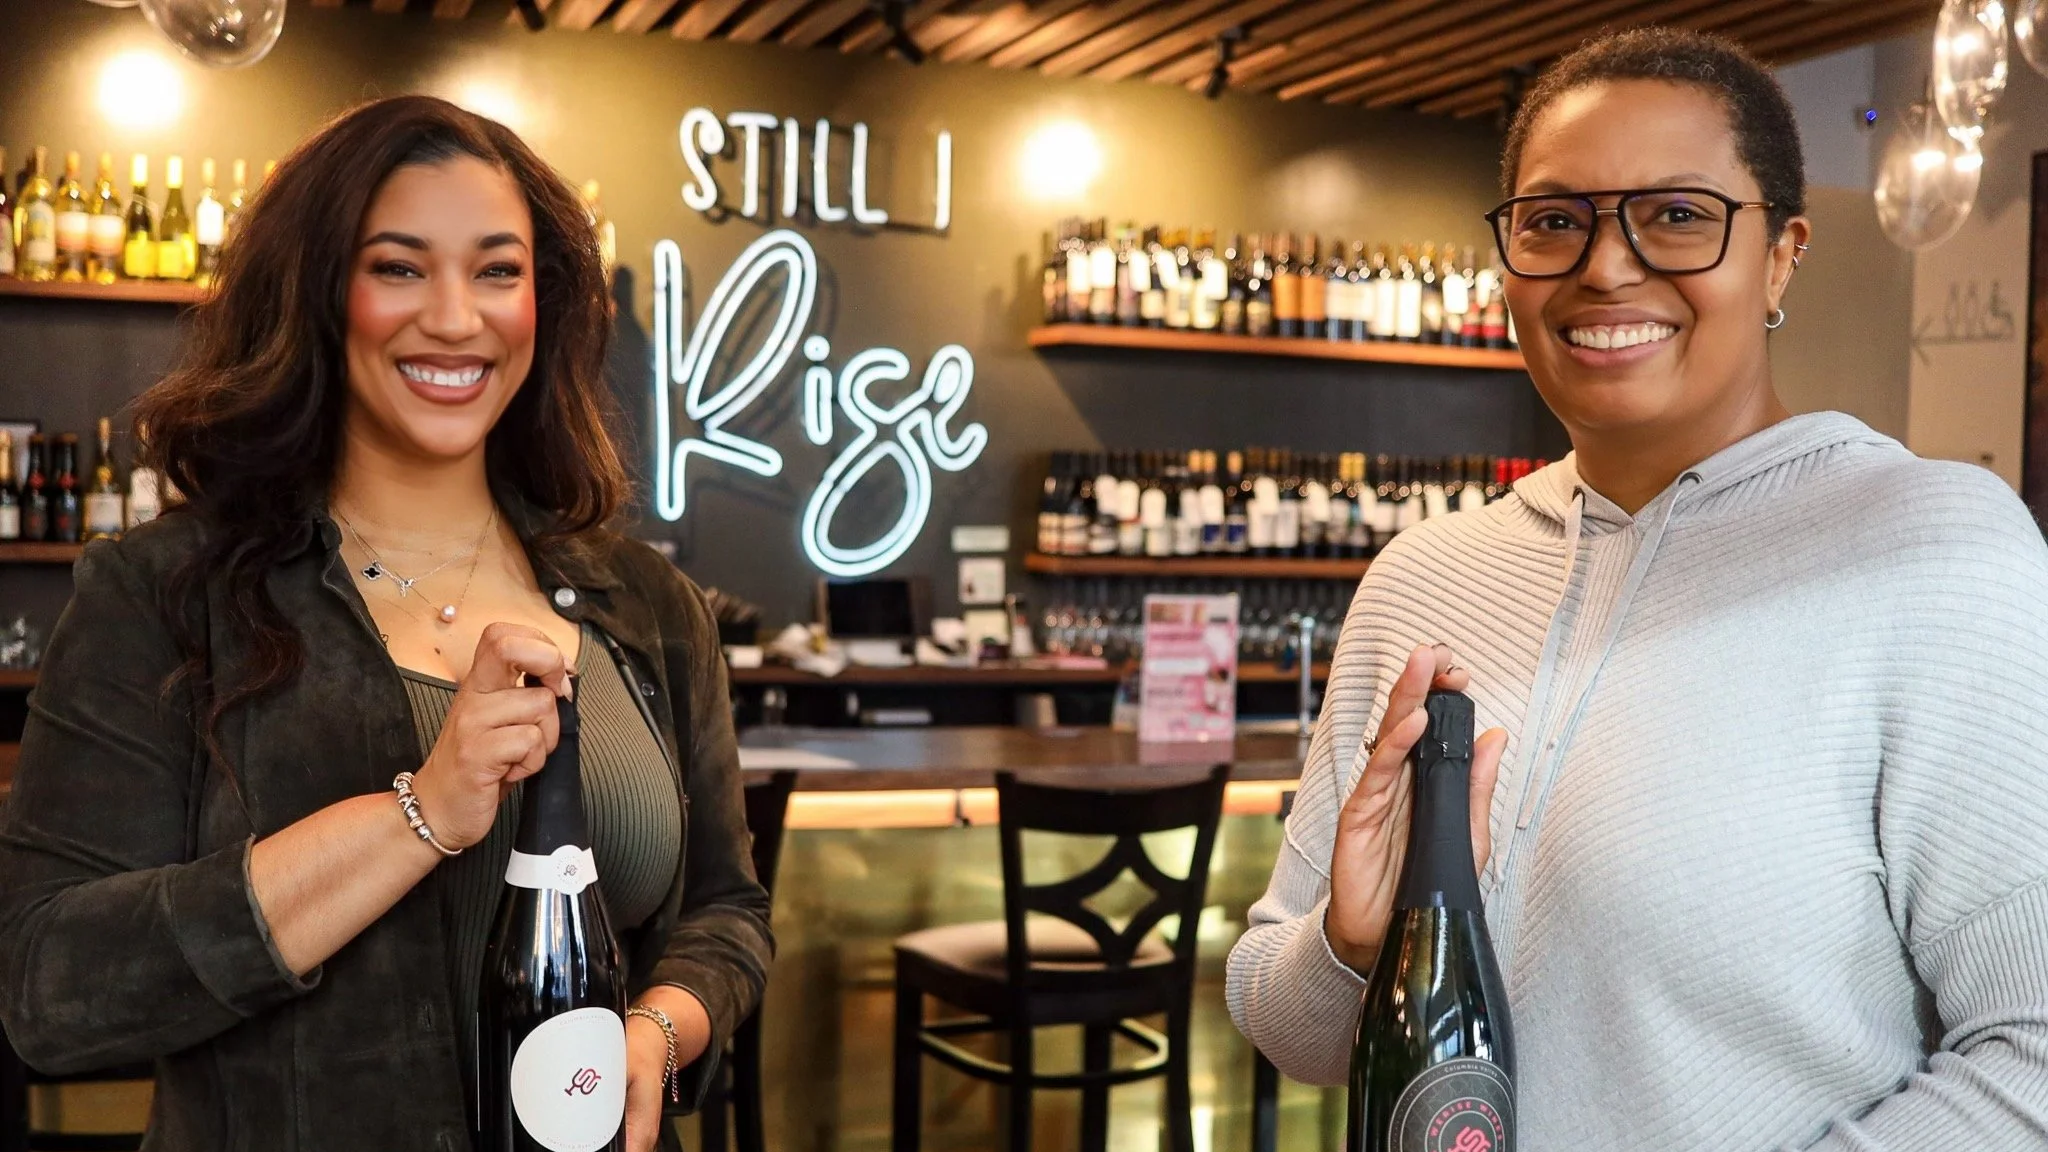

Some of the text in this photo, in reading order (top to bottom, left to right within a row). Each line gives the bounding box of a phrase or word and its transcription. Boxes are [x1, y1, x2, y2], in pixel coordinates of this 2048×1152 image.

[679, 107, 952, 230] STILL I
[653, 228, 989, 577] Rise
[1479, 1103, 1503, 1141] WINES
